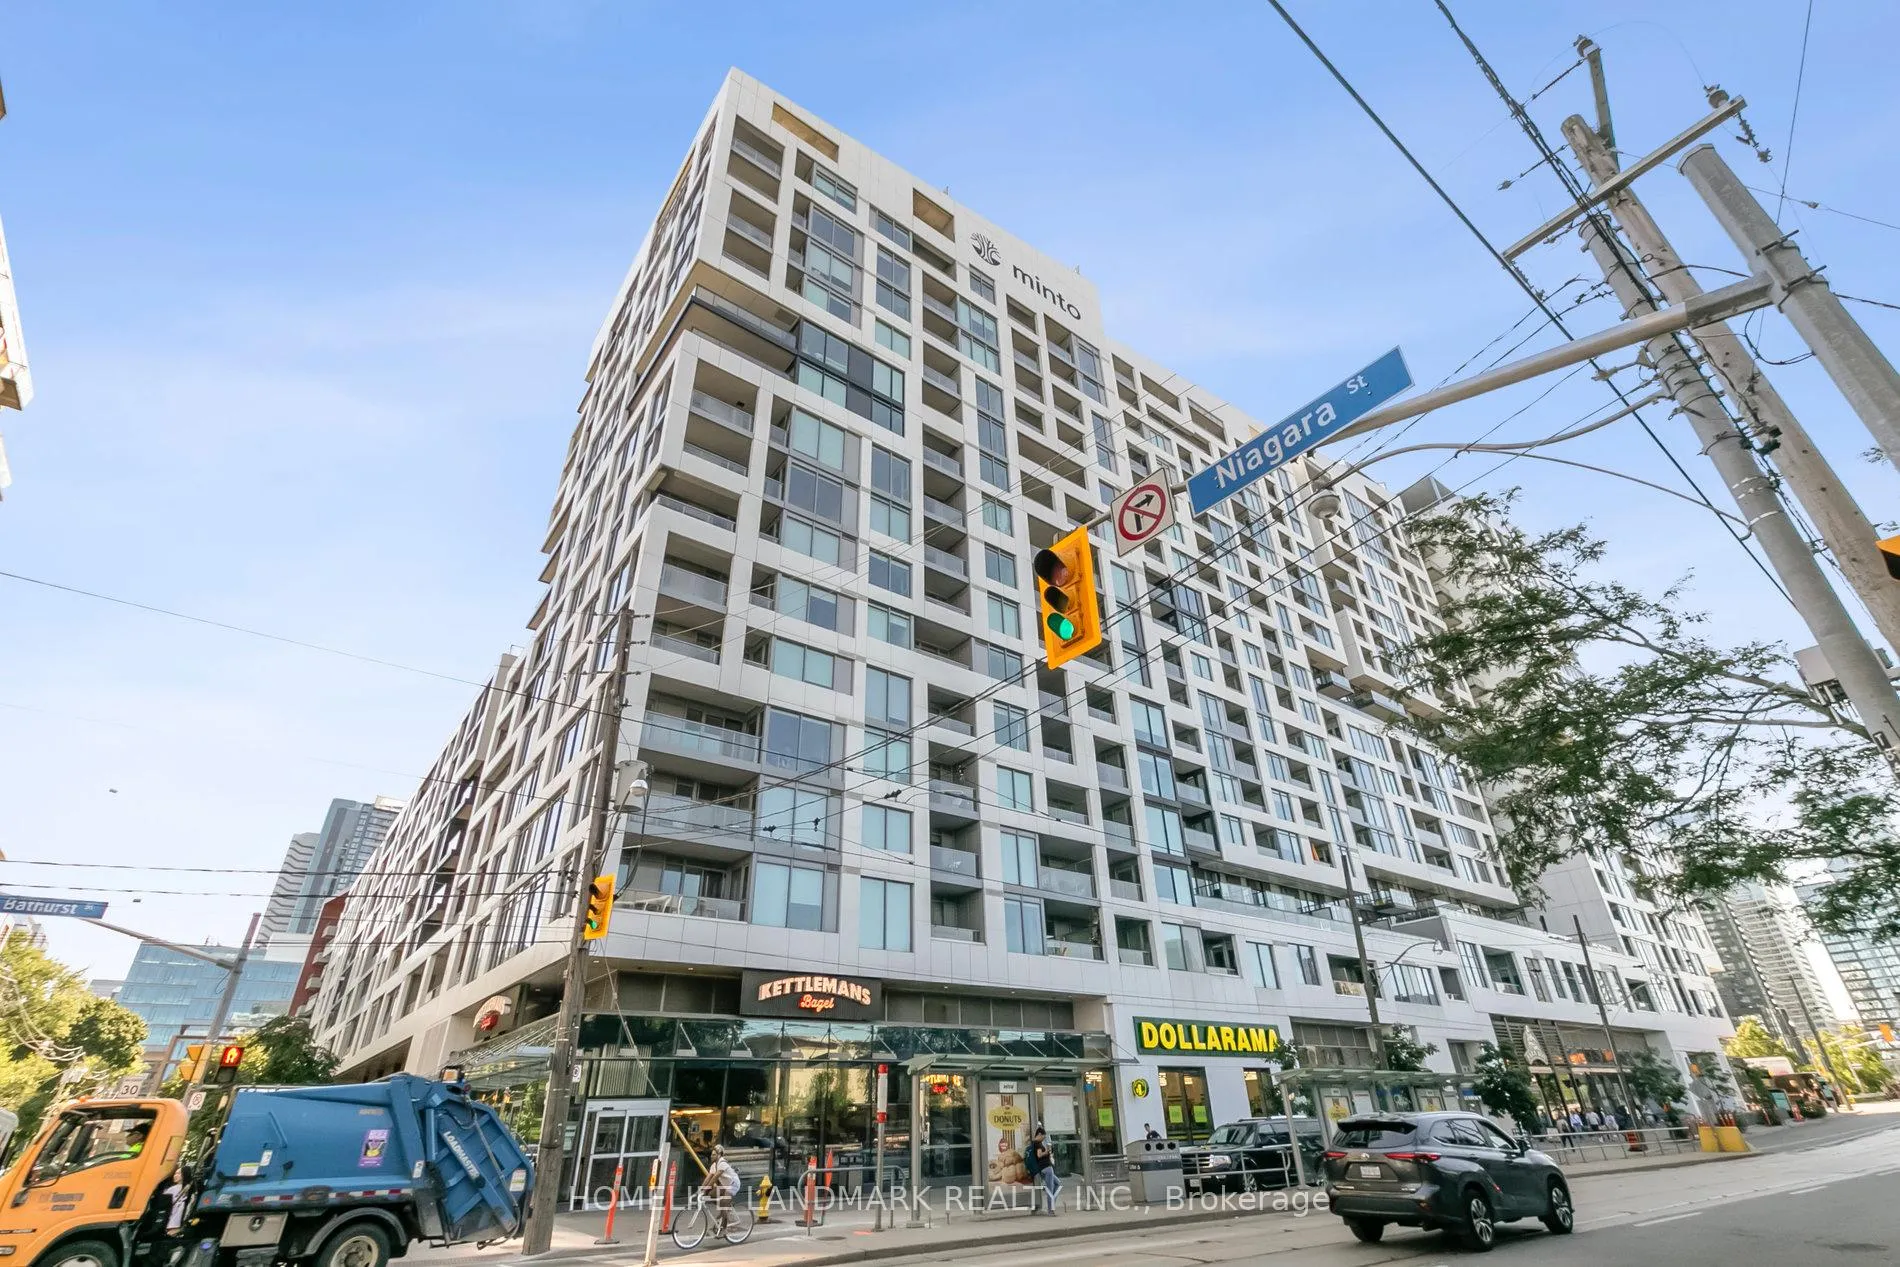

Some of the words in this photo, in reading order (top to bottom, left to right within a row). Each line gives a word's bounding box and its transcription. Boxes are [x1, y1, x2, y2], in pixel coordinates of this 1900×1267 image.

[1013, 264, 1081, 320] minto
[1216, 401, 1337, 489] Niagara
[1346, 375, 1368, 394] St
[3, 898, 79, 915] Bathurst
[758, 976, 871, 1006] KETTLEMANS
[799, 994, 834, 1013] Bagel
[1141, 1021, 1279, 1053] DOLLARAMA
[121, 1085, 138, 1095] 30
[994, 1114, 1022, 1124] DONUTS
